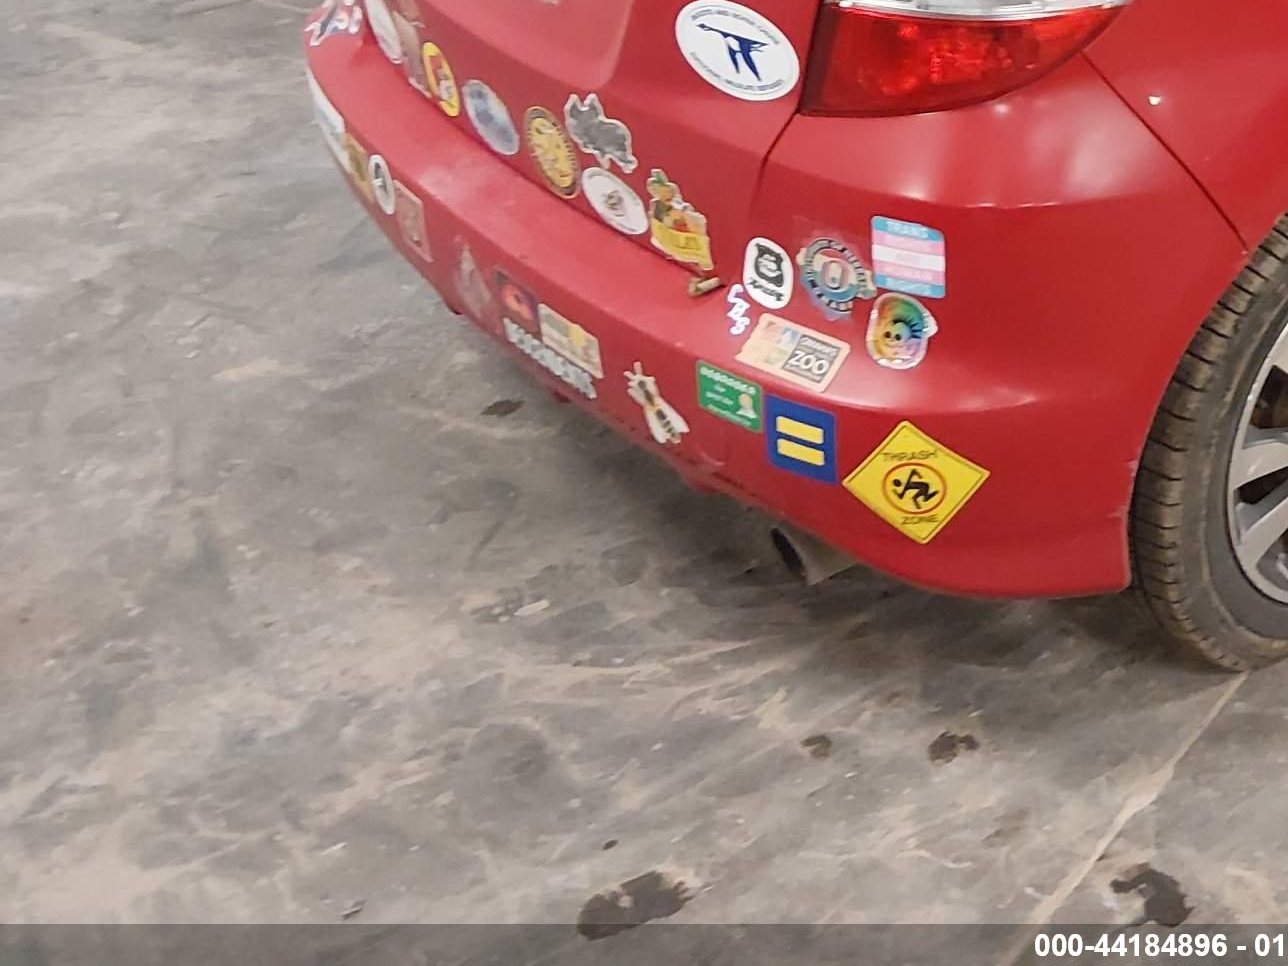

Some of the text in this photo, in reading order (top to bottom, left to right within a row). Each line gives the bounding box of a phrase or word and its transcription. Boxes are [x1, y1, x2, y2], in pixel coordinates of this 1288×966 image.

[787, 350, 830, 375] ZOO
[882, 448, 939, 462] THRASH
[900, 514, 939, 526] ZONE
